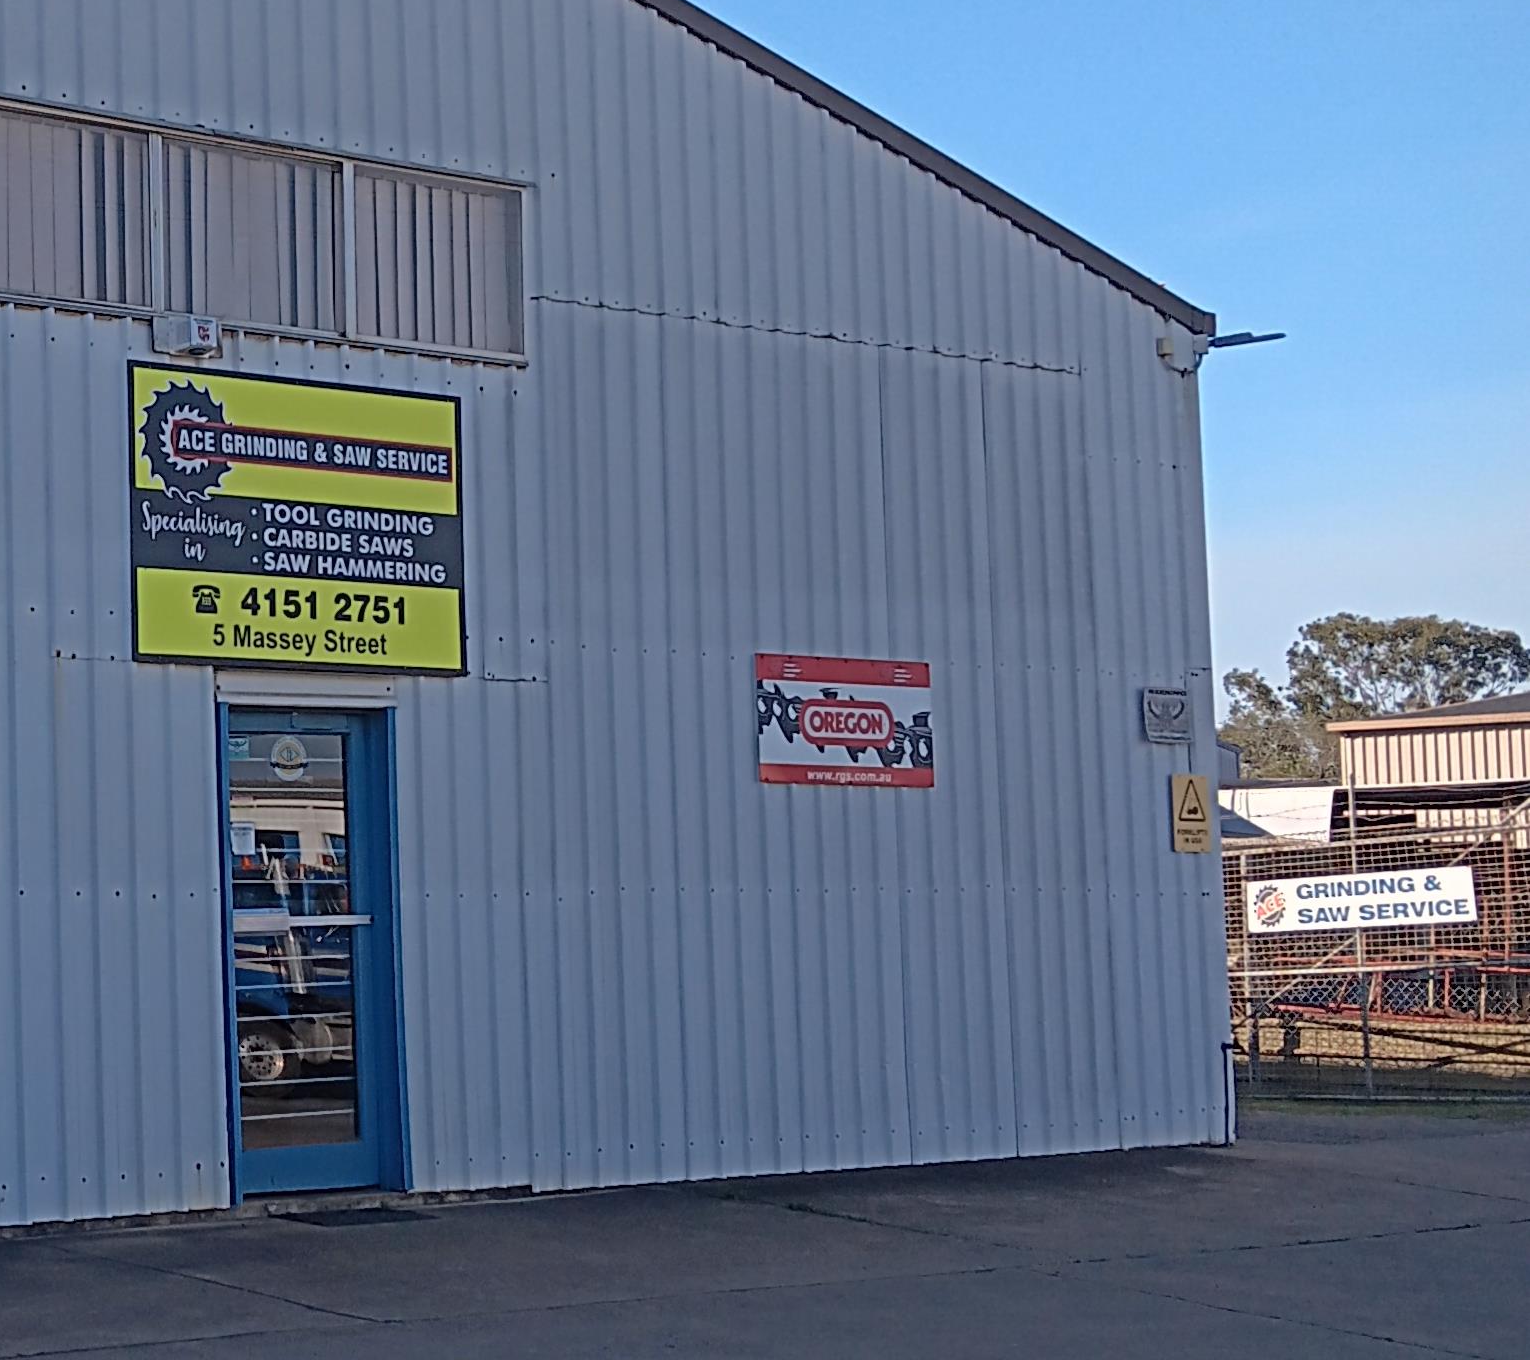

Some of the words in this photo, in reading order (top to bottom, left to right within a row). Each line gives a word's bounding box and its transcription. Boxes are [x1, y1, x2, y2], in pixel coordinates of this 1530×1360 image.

[178, 429, 216, 453] ACE
[221, 433, 308, 462] GRINDING
[314, 444, 328, 464] &
[333, 444, 372, 467] SAW
[376, 448, 449, 475] SERVICE
[141, 501, 246, 546] Specialising
[262, 503, 320, 527] TOOL
[326, 509, 434, 536] GRINDING
[183, 538, 206, 562] in
[263, 528, 352, 553] CARBIDE
[358, 536, 414, 558] SAWS
[263, 552, 311, 573] SAW
[317, 556, 447, 584] HAMMERING
[241, 587, 318, 620] 4151
[334, 593, 407, 625] 2751
[213, 624, 226, 647] 5
[233, 624, 317, 657] Massey
[324, 629, 388, 656] Street
[809, 710, 883, 735] OREGON
[807, 770, 892, 783] www.rgs.com.au
[1296, 877, 1415, 900] GRINDING
[1423, 875, 1442, 891] &
[1256, 892, 1285, 920] ACE
[1297, 906, 1351, 925] SAW
[1359, 898, 1470, 921] SERVICE
